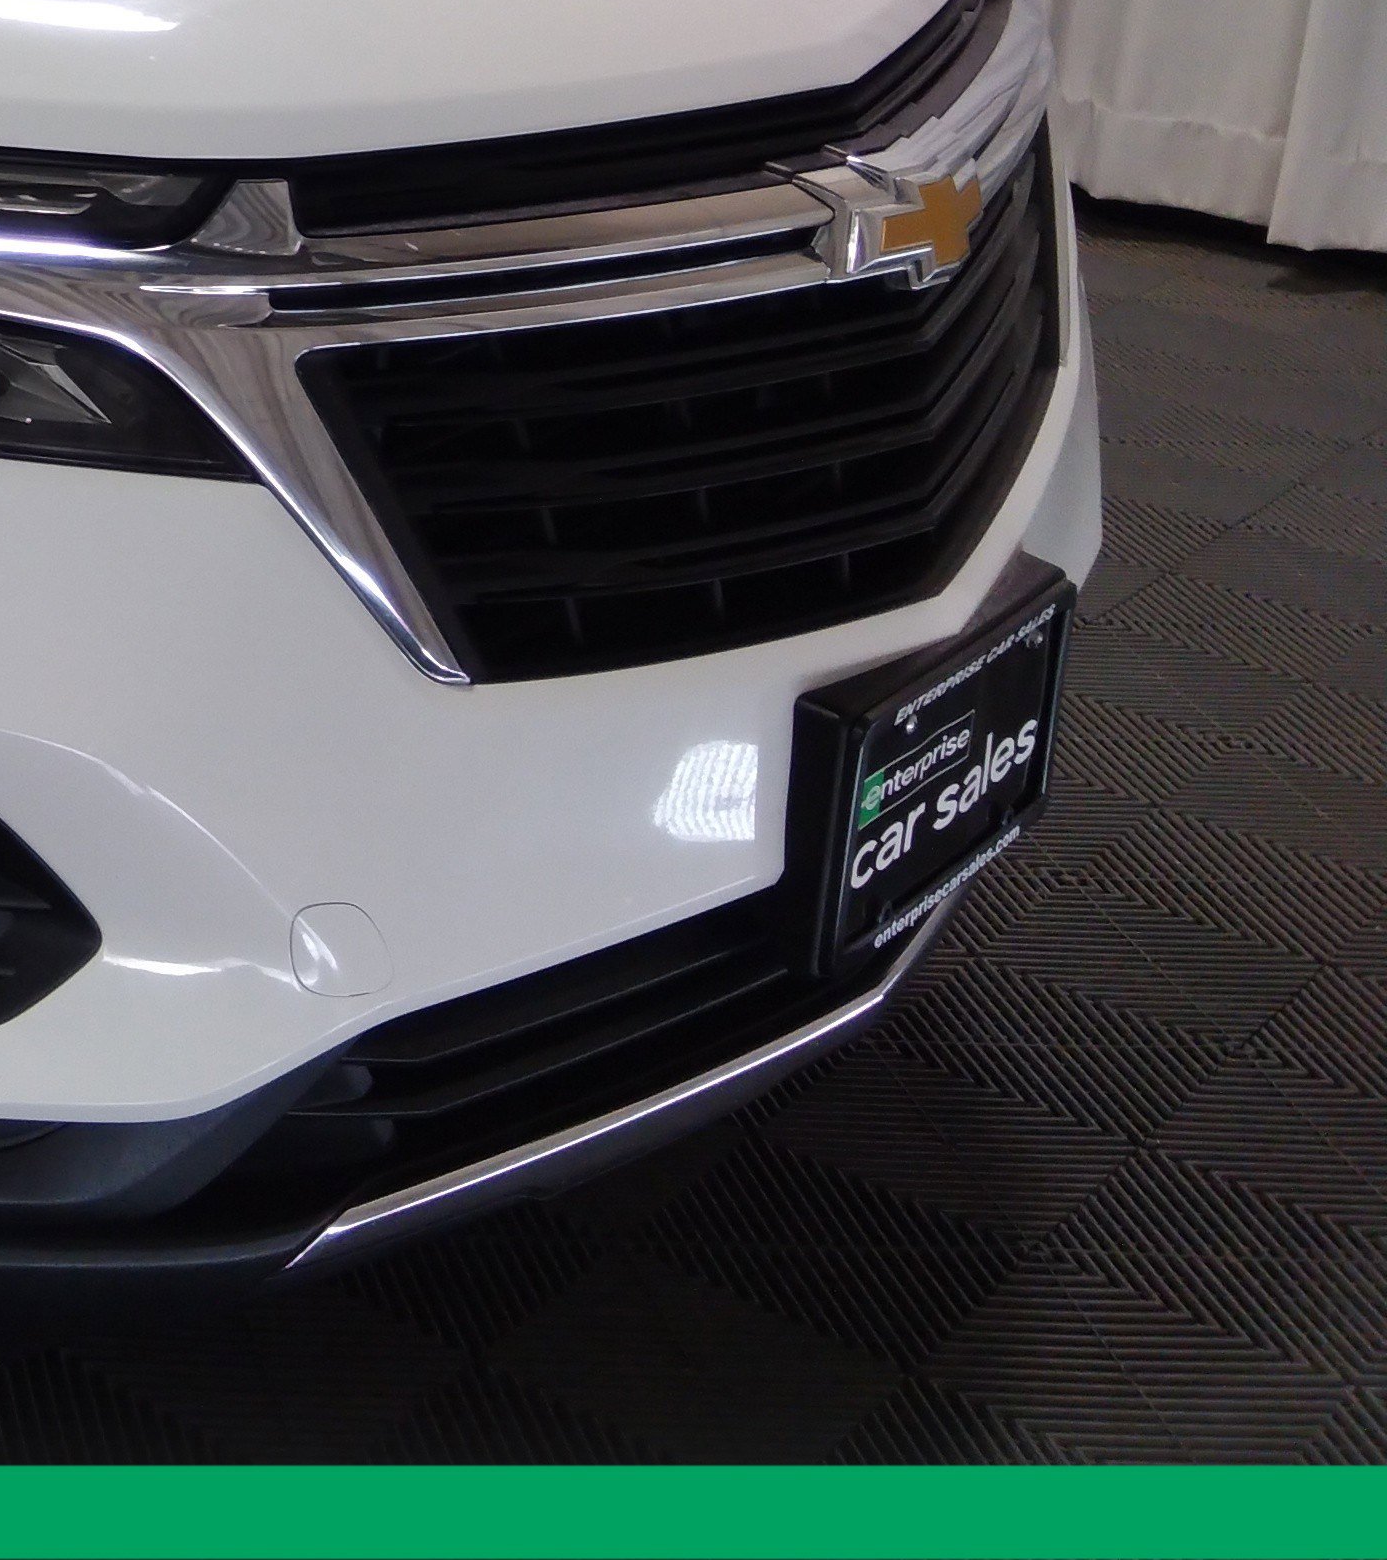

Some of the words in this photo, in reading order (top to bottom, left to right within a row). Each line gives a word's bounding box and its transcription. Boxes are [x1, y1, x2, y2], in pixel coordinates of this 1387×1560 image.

[894, 654, 987, 726] ENTERPRISE
[987, 634, 1015, 664] CAR
[850, 802, 925, 890] car
[933, 719, 1039, 831] sales
[860, 727, 971, 811] enterprise
[873, 825, 1020, 949] enterprisecarsales.com
